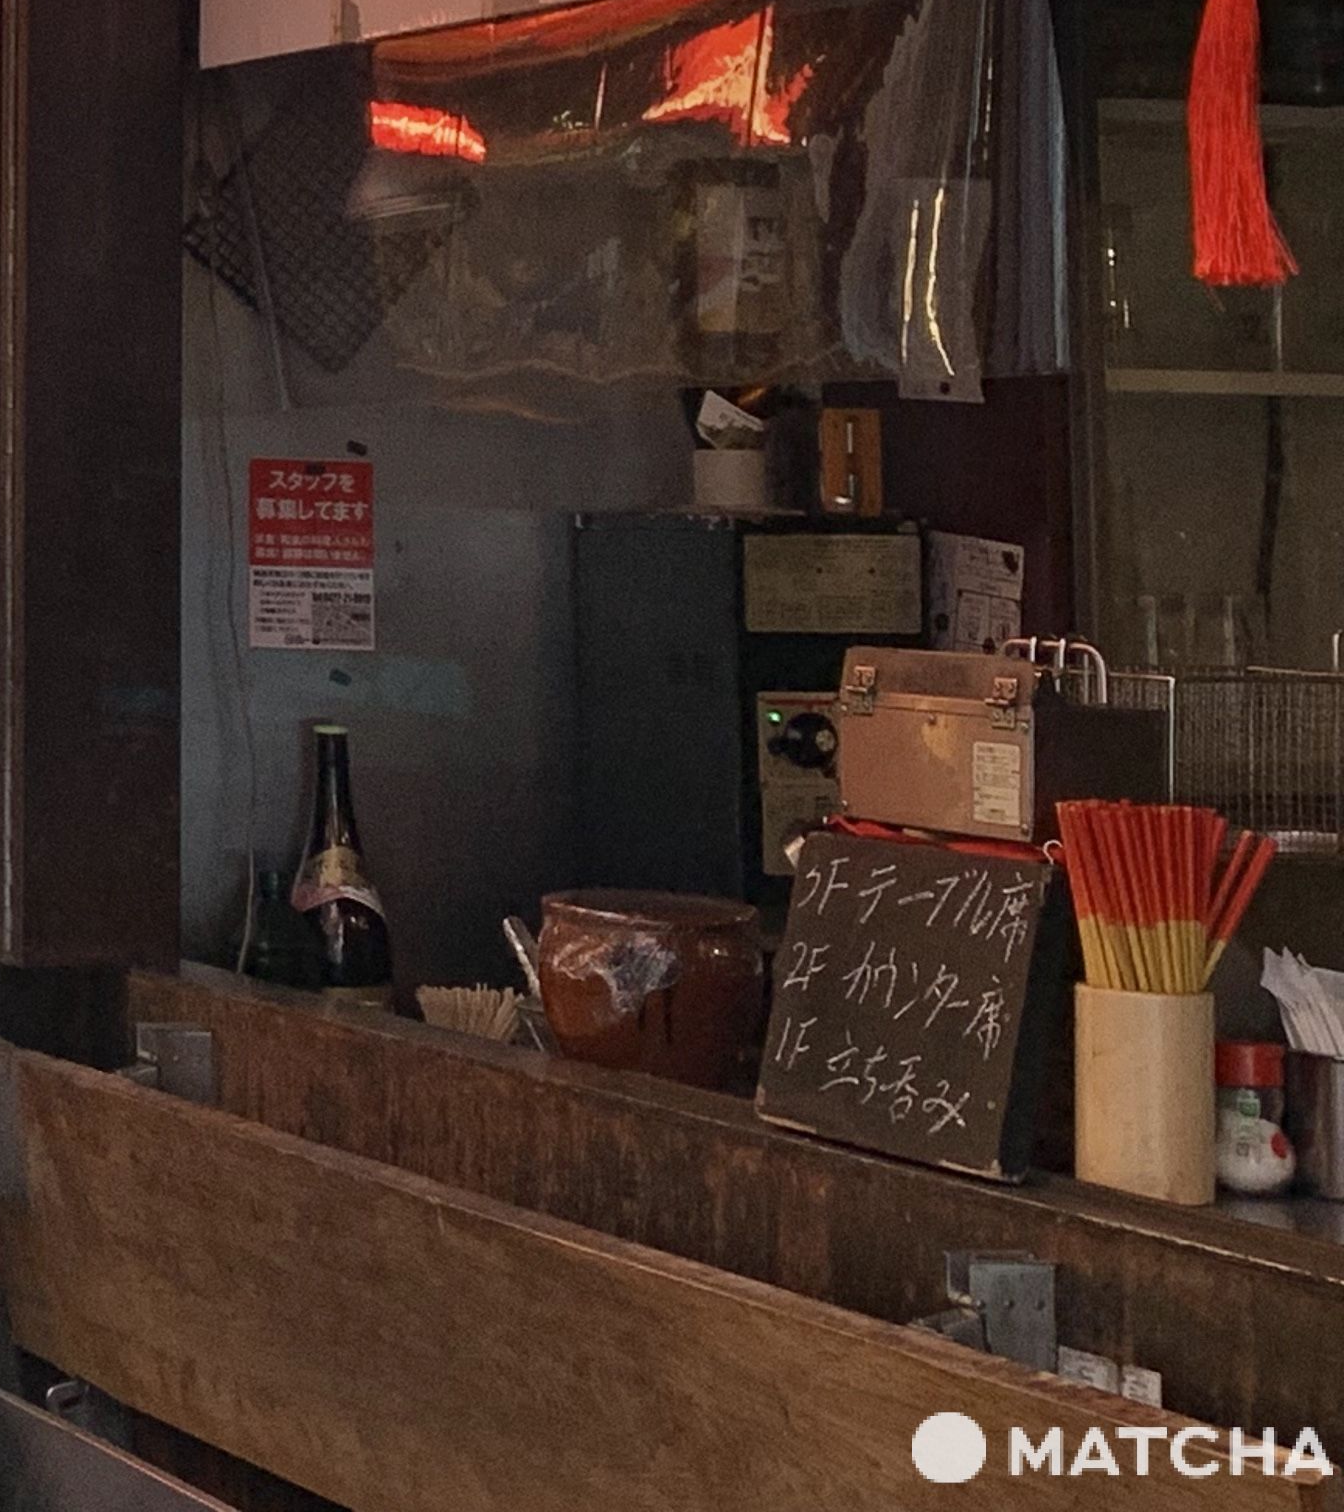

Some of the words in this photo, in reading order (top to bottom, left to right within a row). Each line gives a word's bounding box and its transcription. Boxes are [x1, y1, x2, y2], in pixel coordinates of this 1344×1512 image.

[268, 470, 356, 494] スタッフを
[255, 497, 369, 521] 募集してます
[858, 864, 1033, 964] テーブル席
[781, 940, 831, 992] 2F
[774, 1016, 818, 1071] 1F
